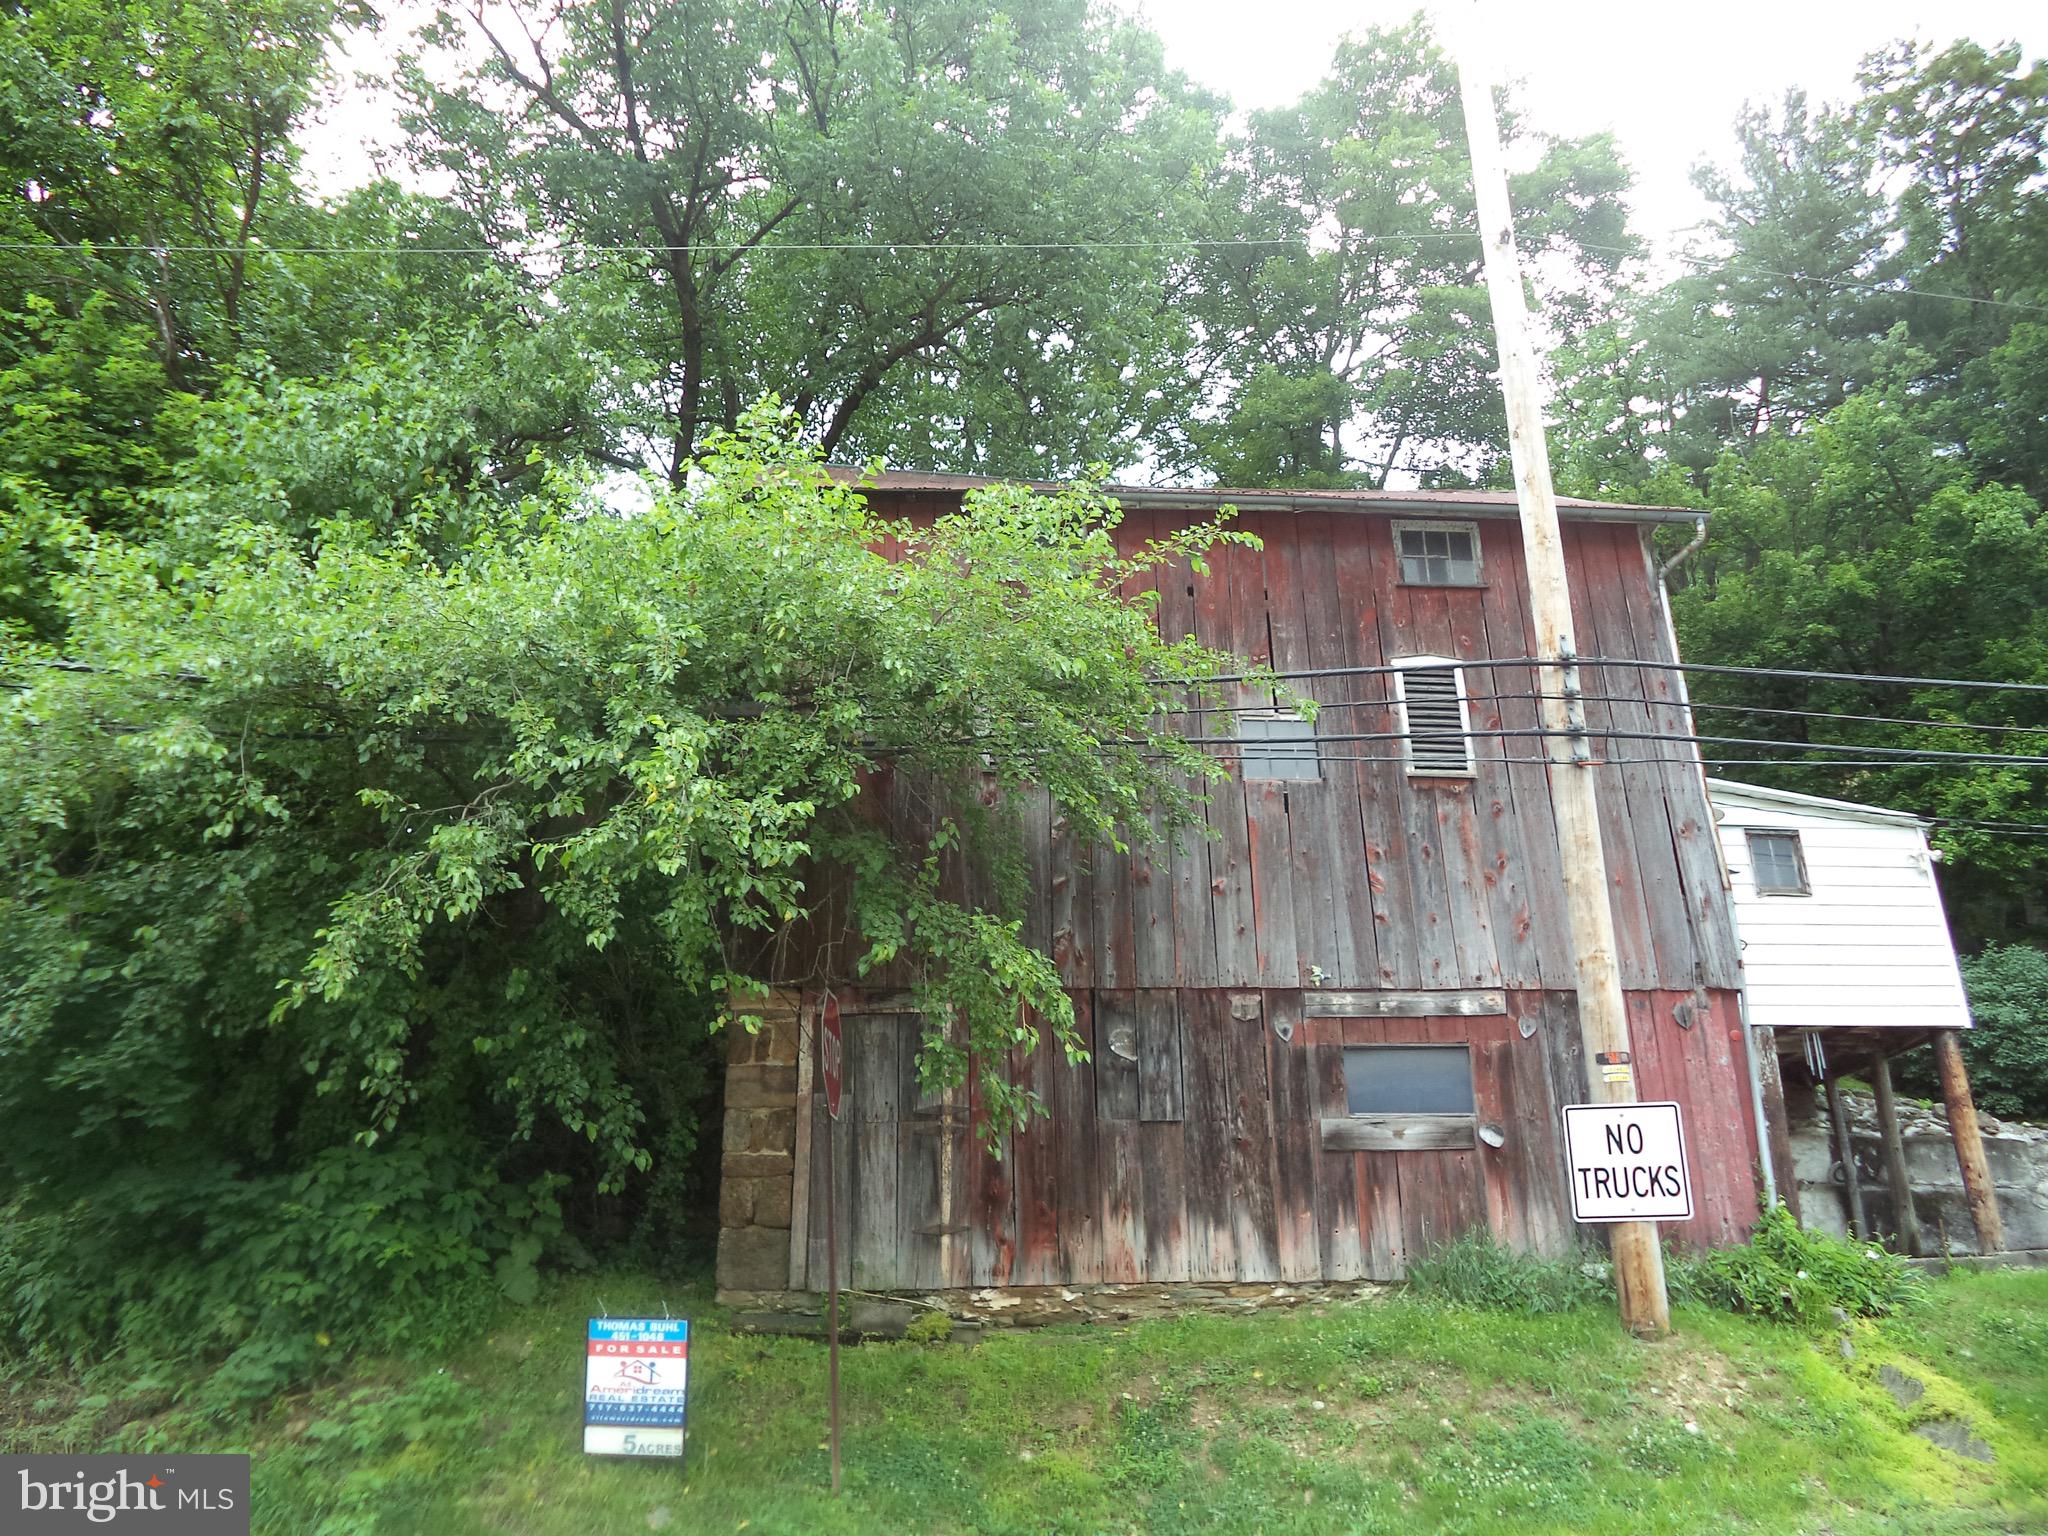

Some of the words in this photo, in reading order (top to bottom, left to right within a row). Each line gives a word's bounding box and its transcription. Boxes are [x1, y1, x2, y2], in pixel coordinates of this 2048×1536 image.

[1605, 1123, 1643, 1155] NO
[1577, 1165, 1681, 1199] TRUCKS
[597, 1321, 646, 1332] THOMAS
[595, 1344, 630, 1353] FOR
[636, 1345, 681, 1354] SALE
[590, 1394, 623, 1402] REAL
[631, 1395, 685, 1403] ESTATE
[623, 1434, 636, 1454] 5
[637, 1443, 682, 1455] ACRES
